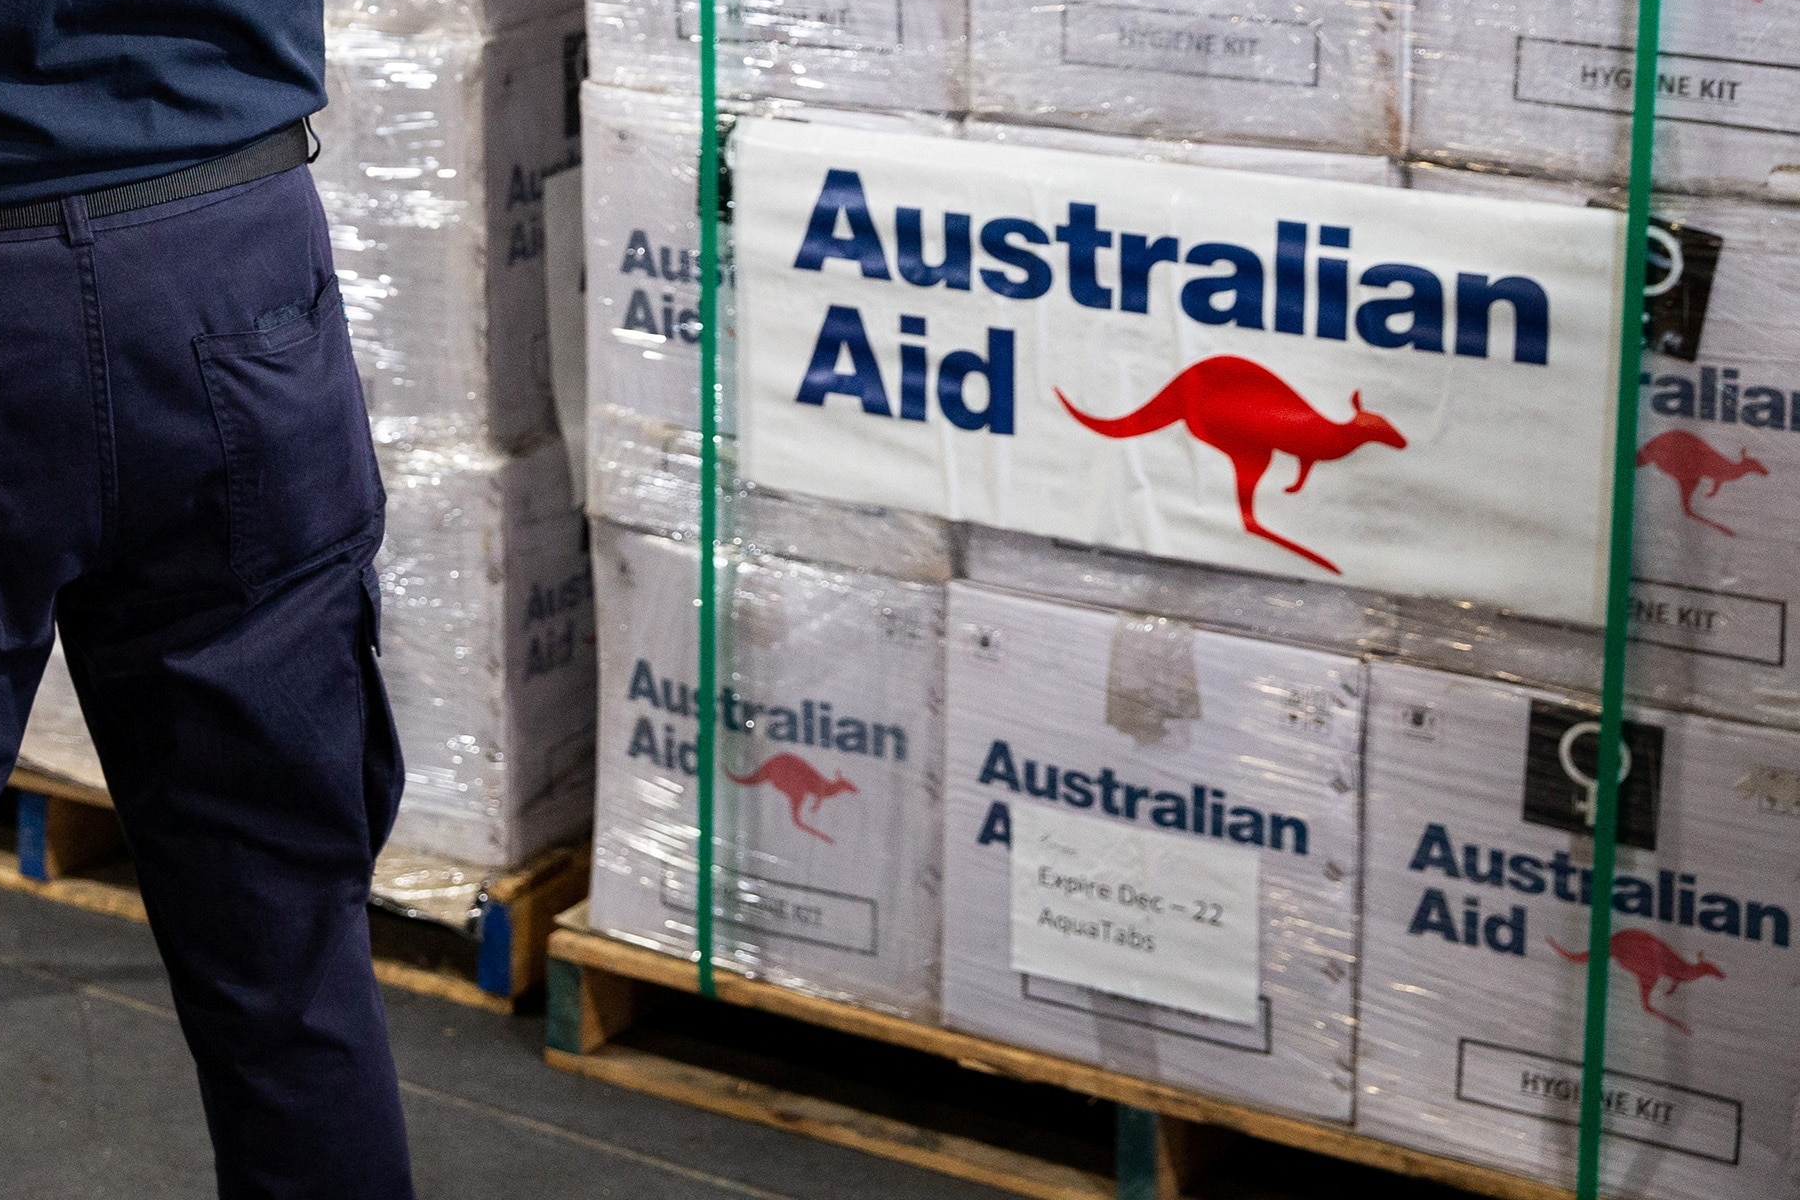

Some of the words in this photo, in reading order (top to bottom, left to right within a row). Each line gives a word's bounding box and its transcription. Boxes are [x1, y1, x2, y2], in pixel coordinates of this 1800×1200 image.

[1700, 77, 1741, 101] KIT
[794, 167, 1552, 367] Australian
[794, 304, 1016, 436] Aid
[1678, 607, 1719, 631] KIT
[977, 740, 1310, 856] Australian
[1037, 864, 1112, 900] Expire
[1192, 899, 1223, 928] 22
[1407, 888, 1527, 957] Aid
[1636, 1097, 1675, 1122] KIT
